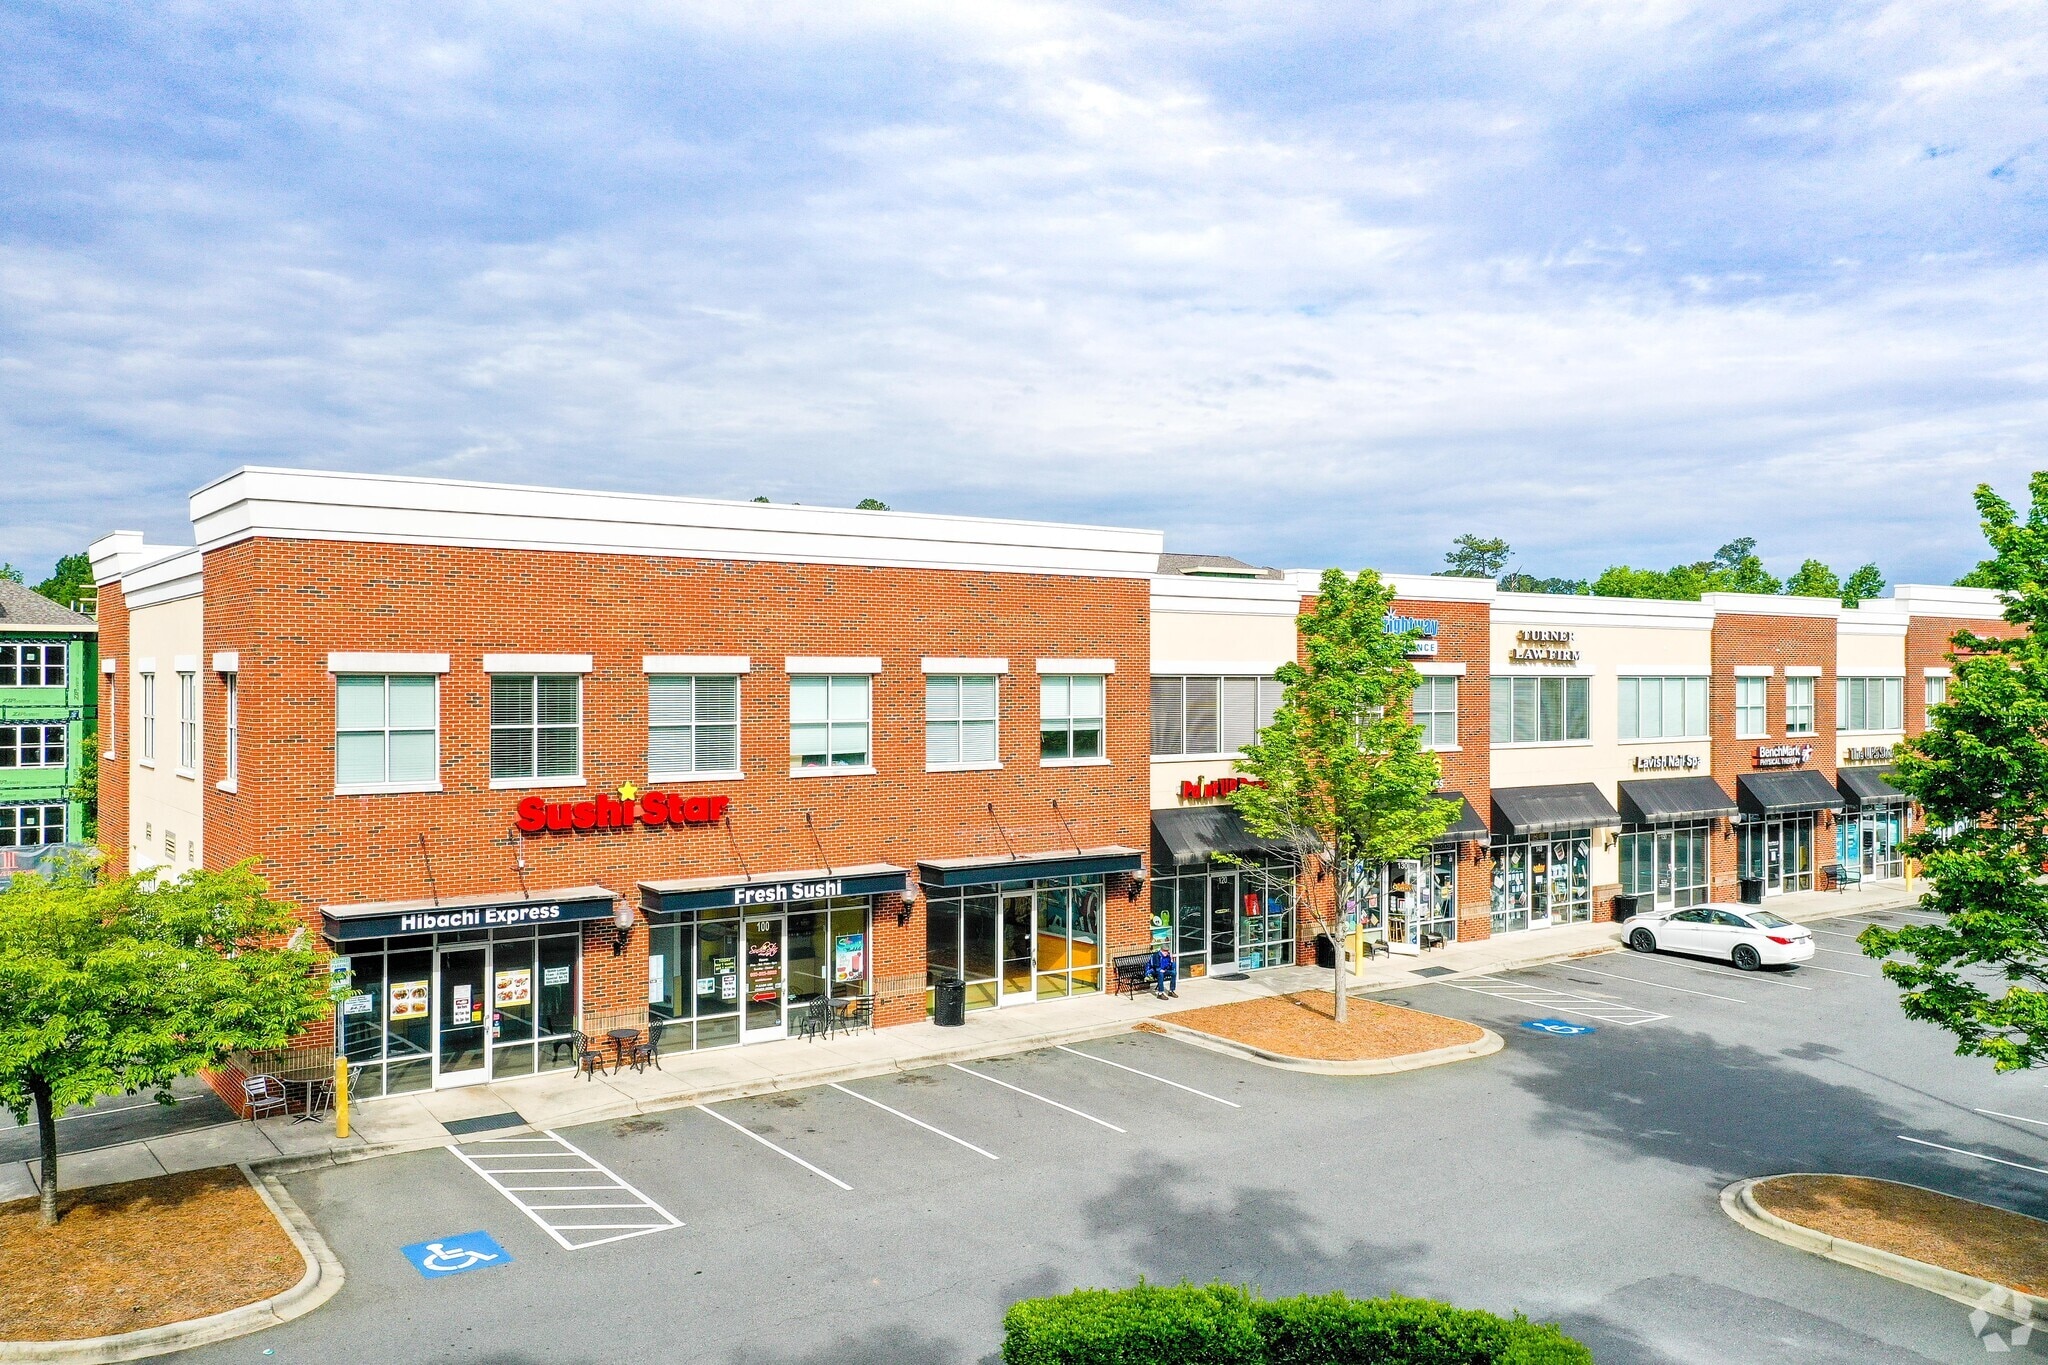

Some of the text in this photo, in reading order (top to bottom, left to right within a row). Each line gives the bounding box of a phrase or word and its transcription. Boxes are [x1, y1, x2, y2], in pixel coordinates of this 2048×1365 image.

[1522, 630, 1575, 642] TURNER
[1514, 648, 1580, 661] LAW FIRM
[1759, 744, 1801, 758] BenchMark
[1637, 754, 1703, 769] Lavish Nail Spa
[516, 790, 730, 832] Sushi Star
[734, 879, 842, 905] Fresh Sushi
[401, 905, 560, 931] Hibachi Express
[756, 921, 770, 932] 100
